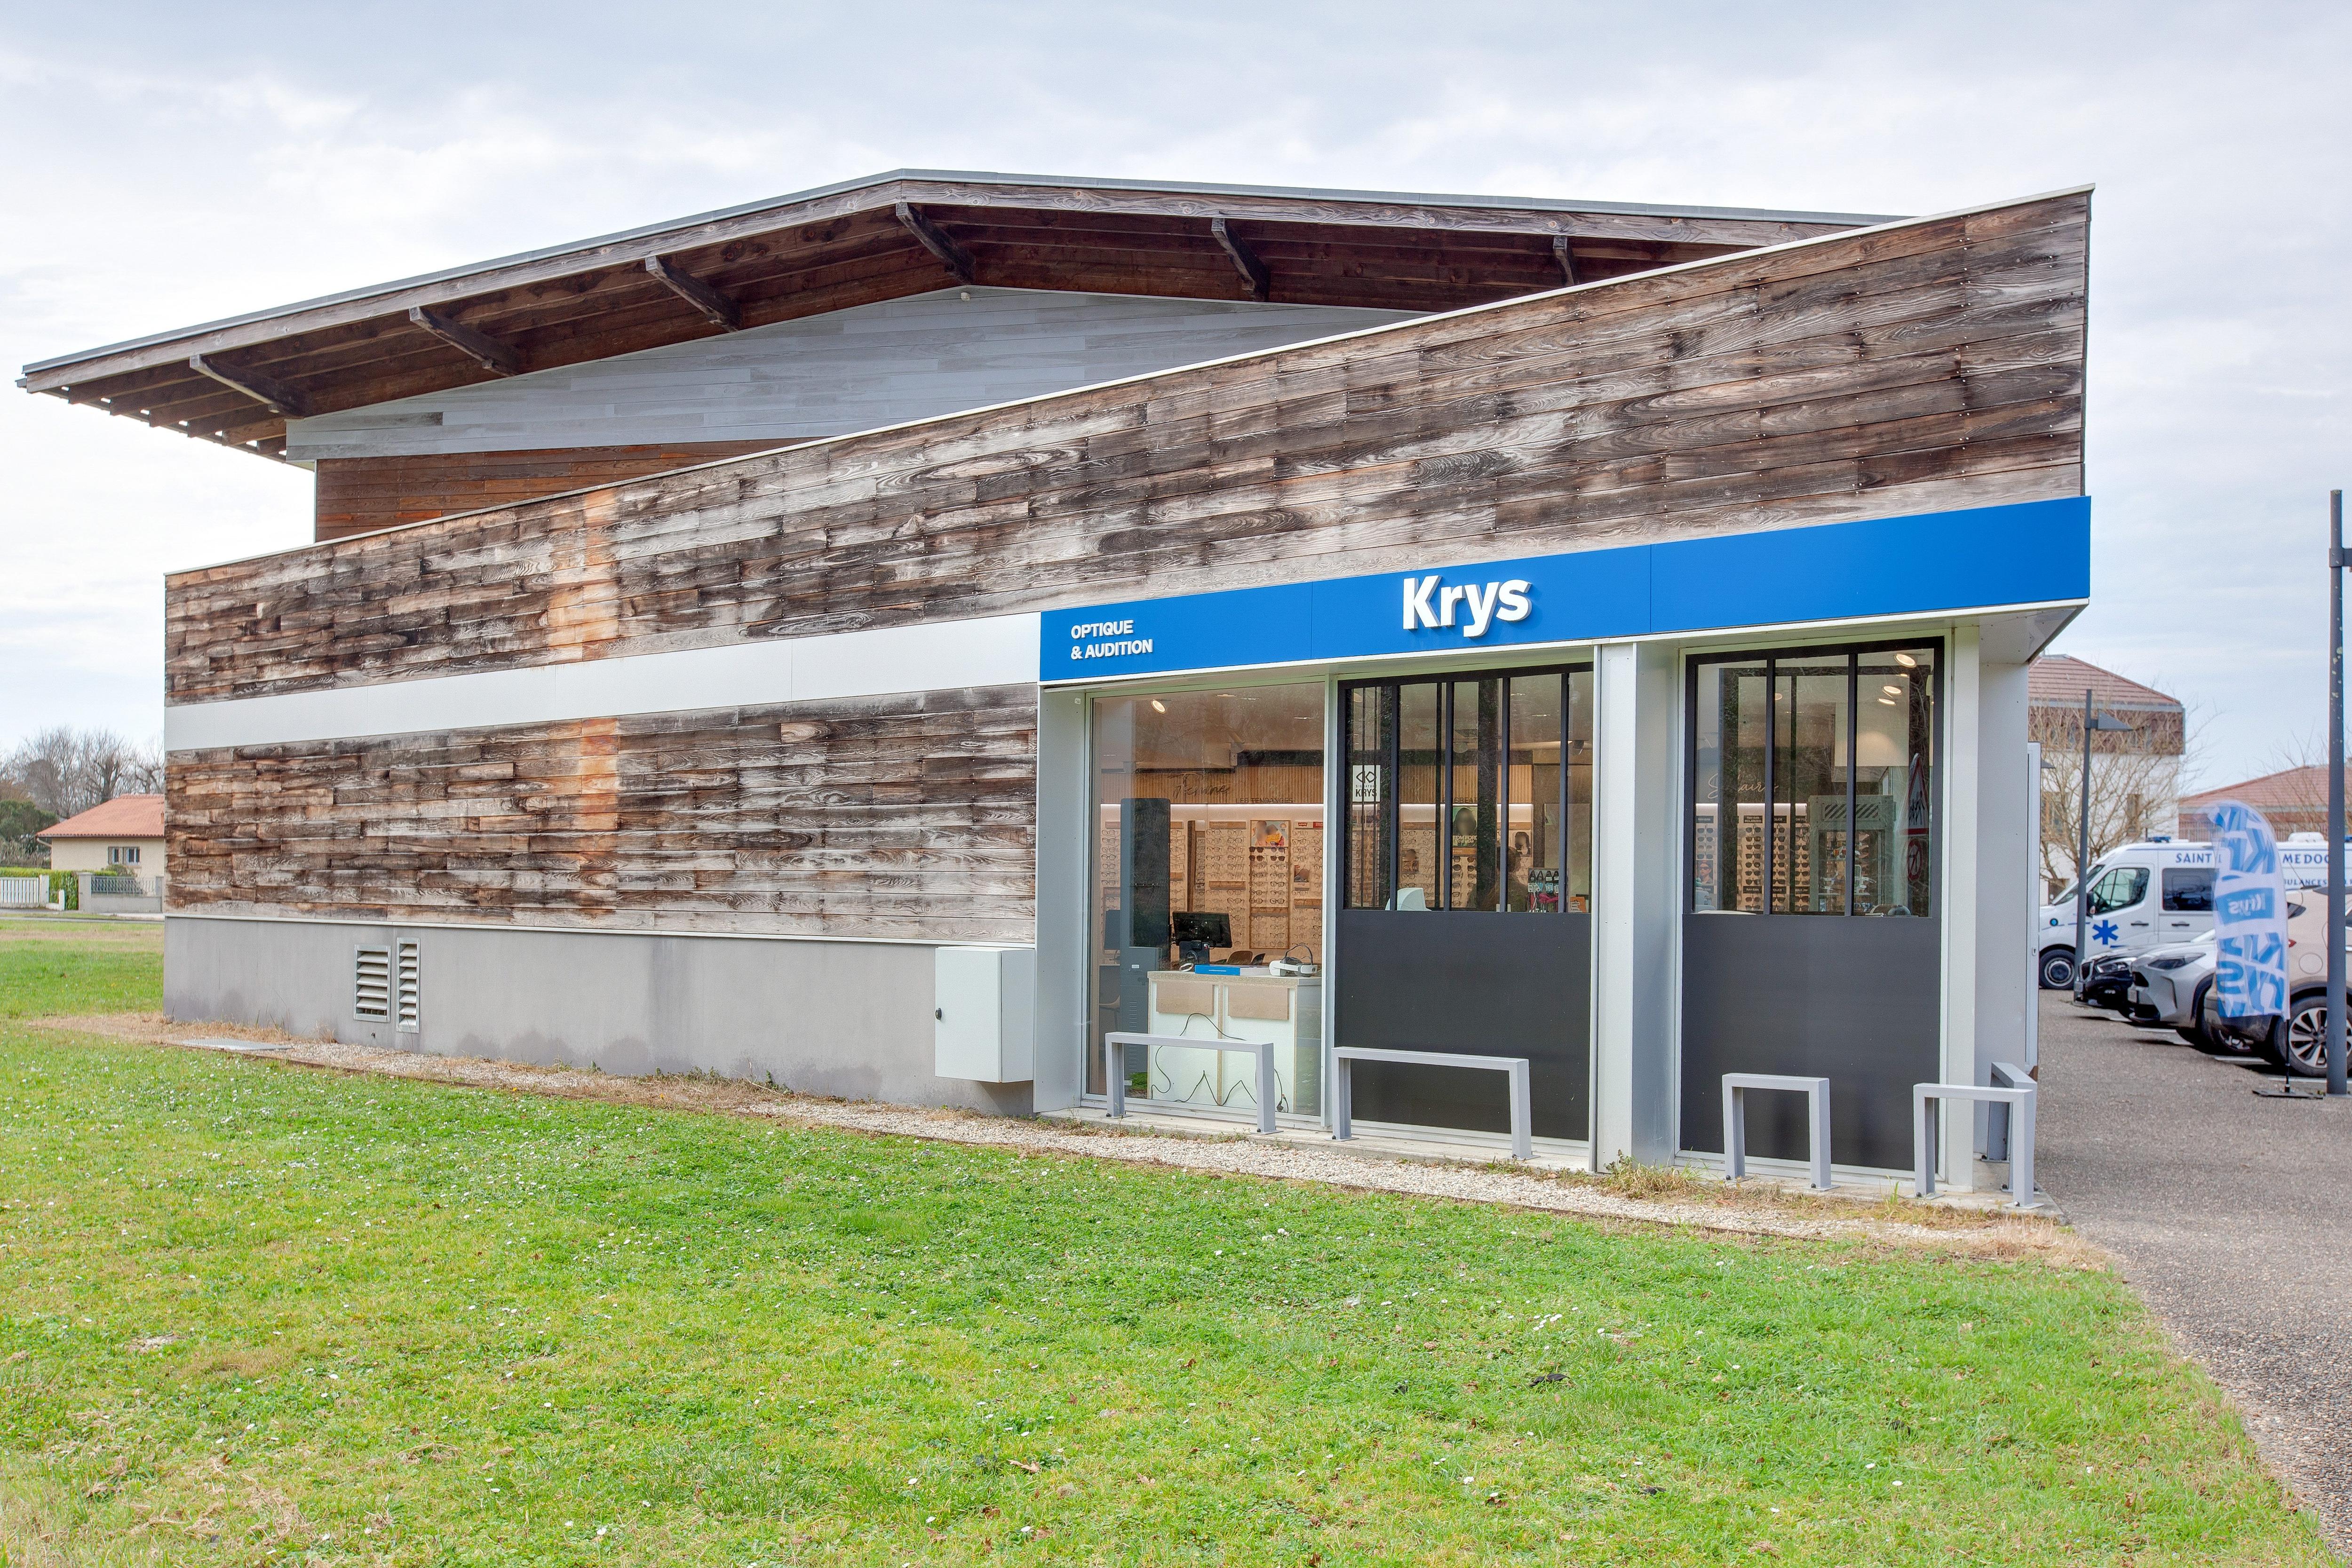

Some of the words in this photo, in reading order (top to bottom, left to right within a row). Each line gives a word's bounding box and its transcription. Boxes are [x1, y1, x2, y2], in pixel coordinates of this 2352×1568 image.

[1403, 575, 1532, 637] Krys
[1071, 620, 1134, 639] OPTIQUE
[1071, 645, 1083, 660] &
[1085, 639, 1153, 659] AUDITION
[1355, 788, 1377, 797] KRYS
[2176, 853, 2212, 863] SAINT
